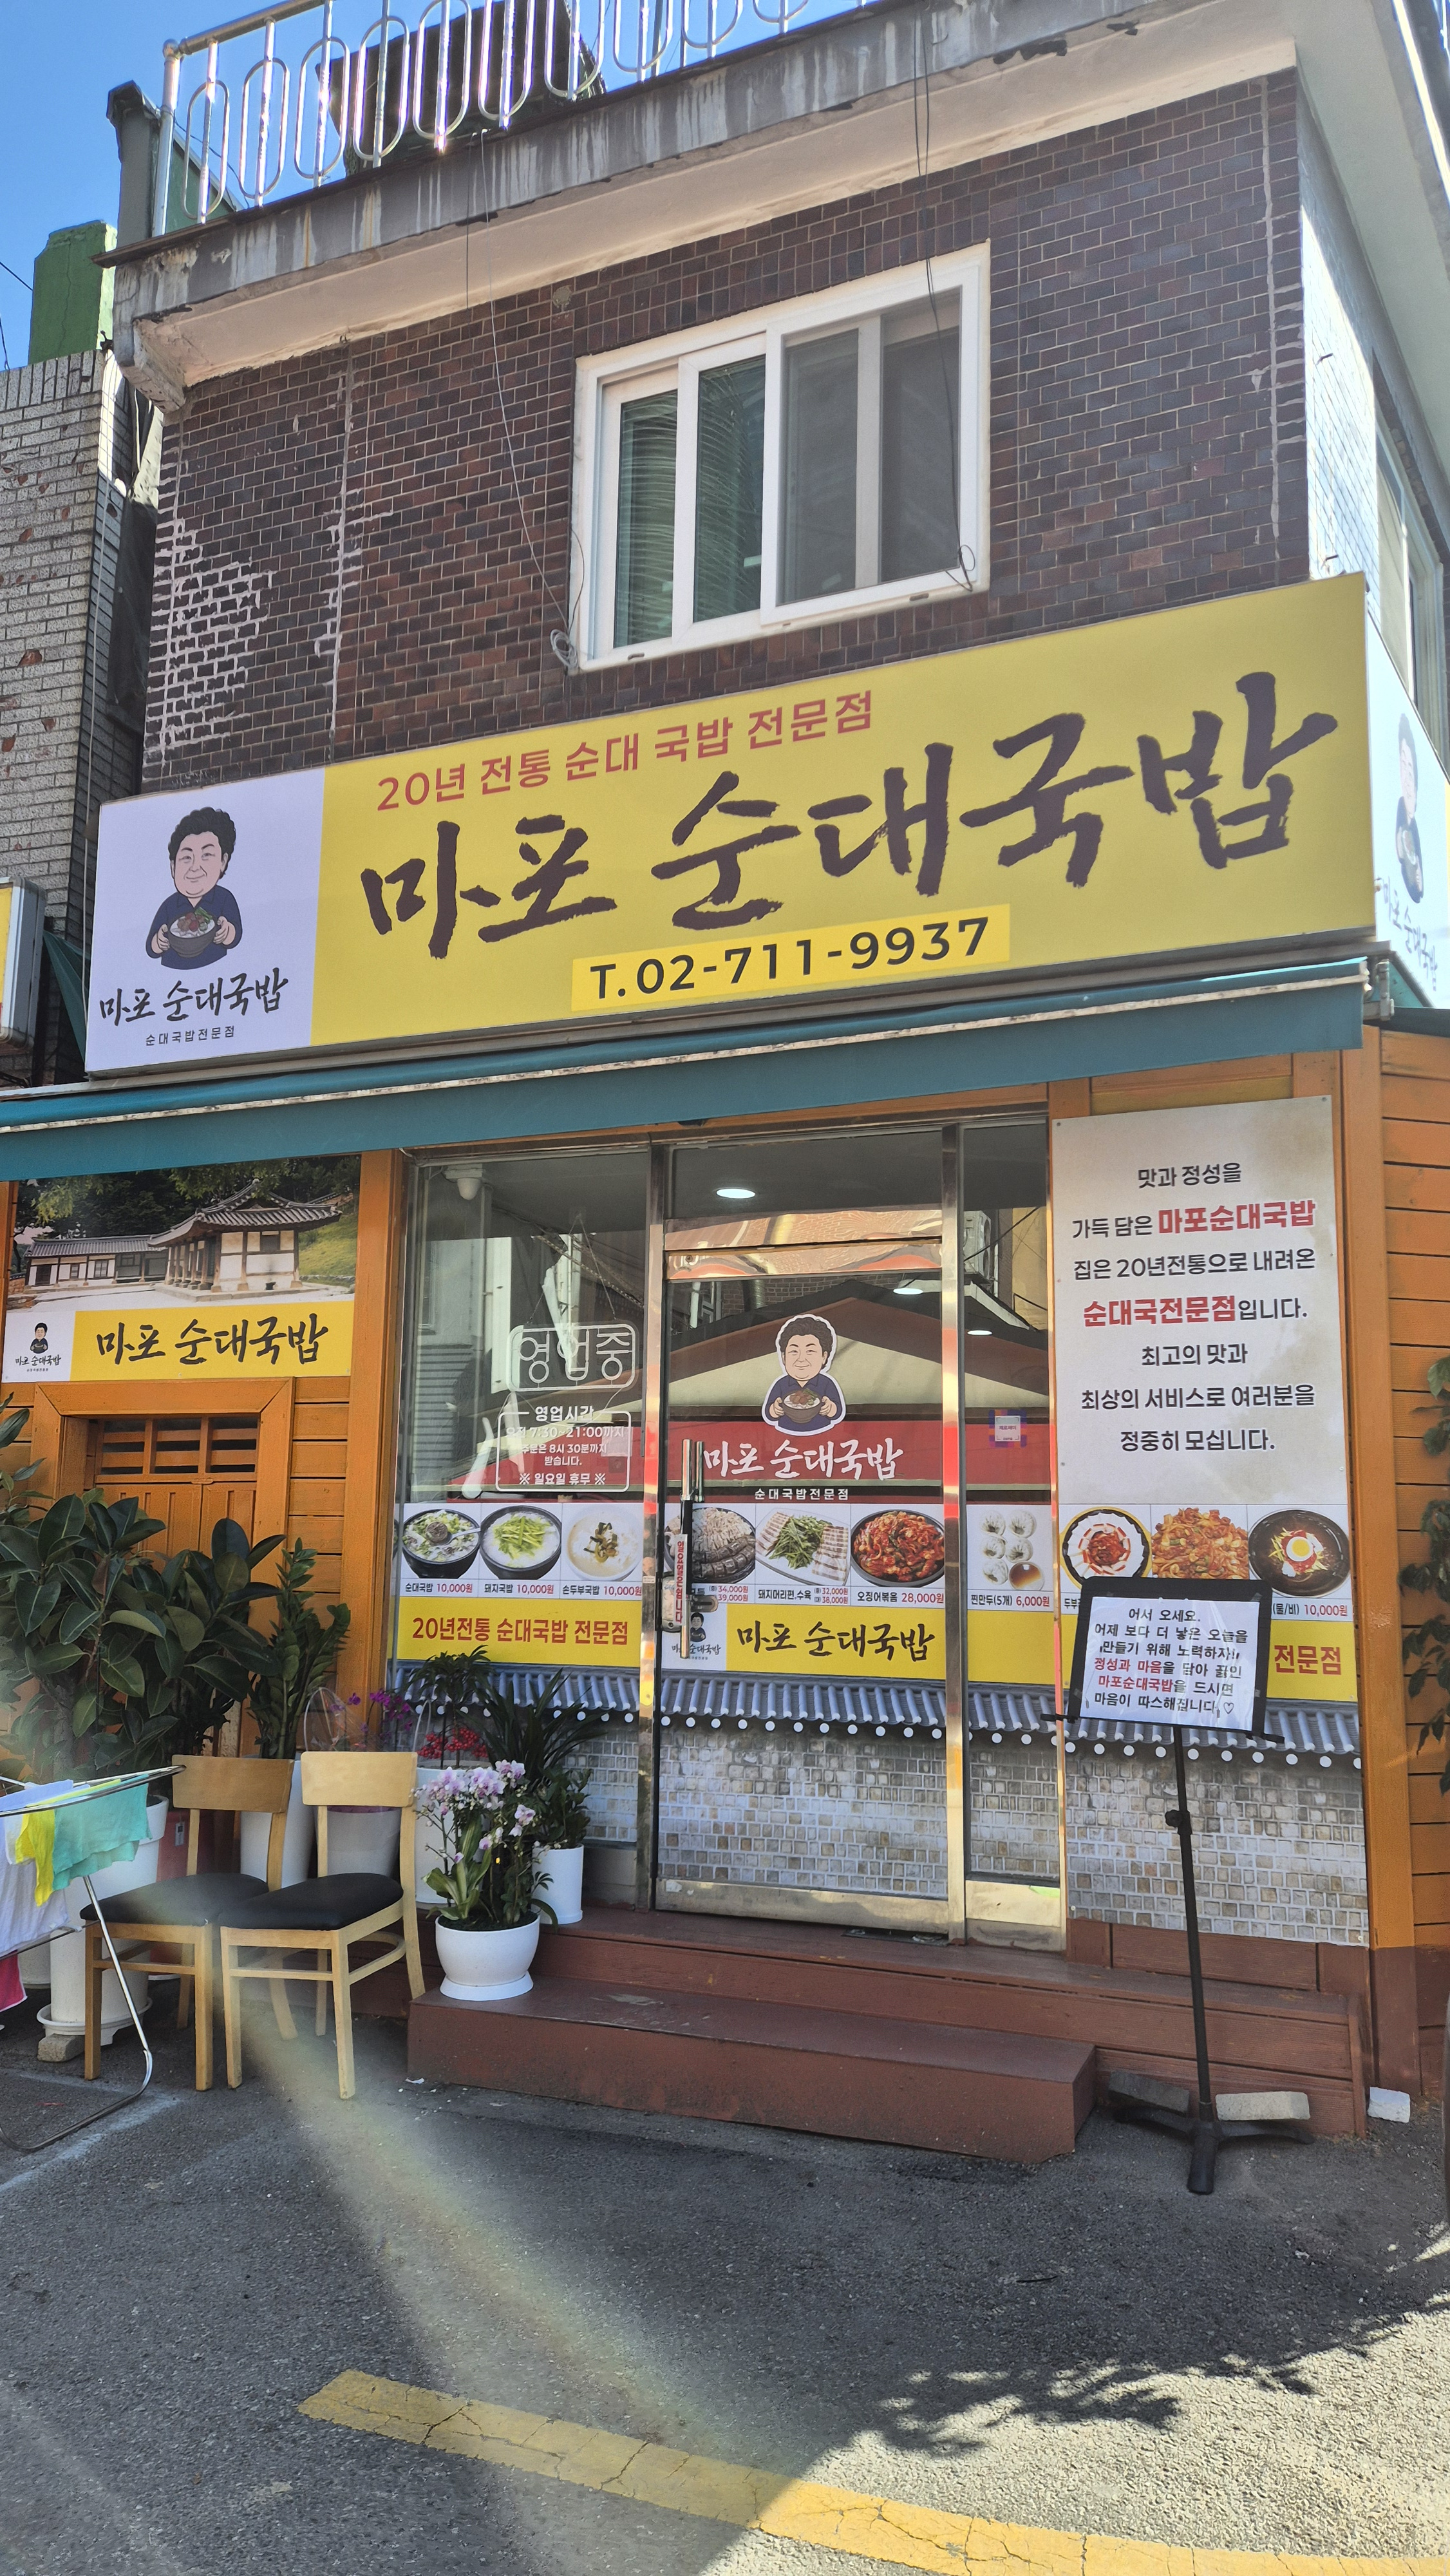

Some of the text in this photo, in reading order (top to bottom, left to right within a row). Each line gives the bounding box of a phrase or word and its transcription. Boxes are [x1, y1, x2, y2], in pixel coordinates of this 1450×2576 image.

[377, 689, 872, 811] 20년 전통 순대 국밥 전문점
[360, 671, 1339, 959] 마포 순대국밥
[99, 967, 288, 1027] 마포 순대국밥
[146, 1025, 234, 1046] 순대국밥전문점
[1138, 1162, 1242, 1189] 맛과 정성을
[1071, 1199, 1316, 1239] 가득 담은 마포순대국밥
[1074, 1248, 1315, 1280] 집은 20년전통으로 내려온
[1083, 1296, 1308, 1327] 순대국전문점입니다.
[97, 1313, 328, 1365] 마포 순대국밥
[31, 1354, 61, 1366] 순대국밥
[519, 1330, 630, 1383] 영업중
[1142, 1343, 1248, 1367] 최고의 맛과
[1082, 1384, 1315, 1410] 최상의 서비스로 여러분을
[535, 1405, 594, 1422] 영업시간
[522, 1444, 607, 1454] 주문은 8시 30분까지
[1120, 1429, 1276, 1452] 정중히 모십니다.
[544, 1456, 582, 1466] 받습니다.
[704, 1437, 903, 1480] 마포 순대국밥
[534, 1473, 565, 1485] 일요일
[569, 1473, 590, 1485] 휴무
[755, 1488, 849, 1501] 순대국밥전문점
[406, 1584, 473, 1594] 순대국밥 10,000원
[484, 1584, 554, 1595] 돼지국밥 10,000원
[563, 1585, 642, 1596] 손두부국밥 10,000원
[857, 1591, 945, 1604] 오징어볶음 28,000원
[971, 1595, 1050, 1607] 찐만두(5개) 6,000원
[1304, 1604, 1347, 1617] 10,000원
[1129, 1608, 1201, 1622] 어서 오세요.
[413, 1618, 628, 1645] 20년전통 순대국밥 전문점
[737, 1620, 936, 1662] 마포 순대국밥
[1095, 1624, 1118, 1636] 어제
[1124, 1625, 1150, 1638] 보다
[1157, 1626, 1169, 1639] 더
[1208, 1629, 1248, 1643] 오늘을
[1102, 1641, 1138, 1655] 만들기
[1146, 1643, 1171, 1656] 위해
[1095, 1658, 1130, 1671] 정성과
[1138, 1660, 1174, 1674] 마음을
[1183, 1662, 1208, 1676] 담아
[1274, 1645, 1341, 1675] 전문점
[1098, 1675, 1233, 1696] 마포순대국밥을 드시면
[1095, 1692, 1130, 1707] 마음이
